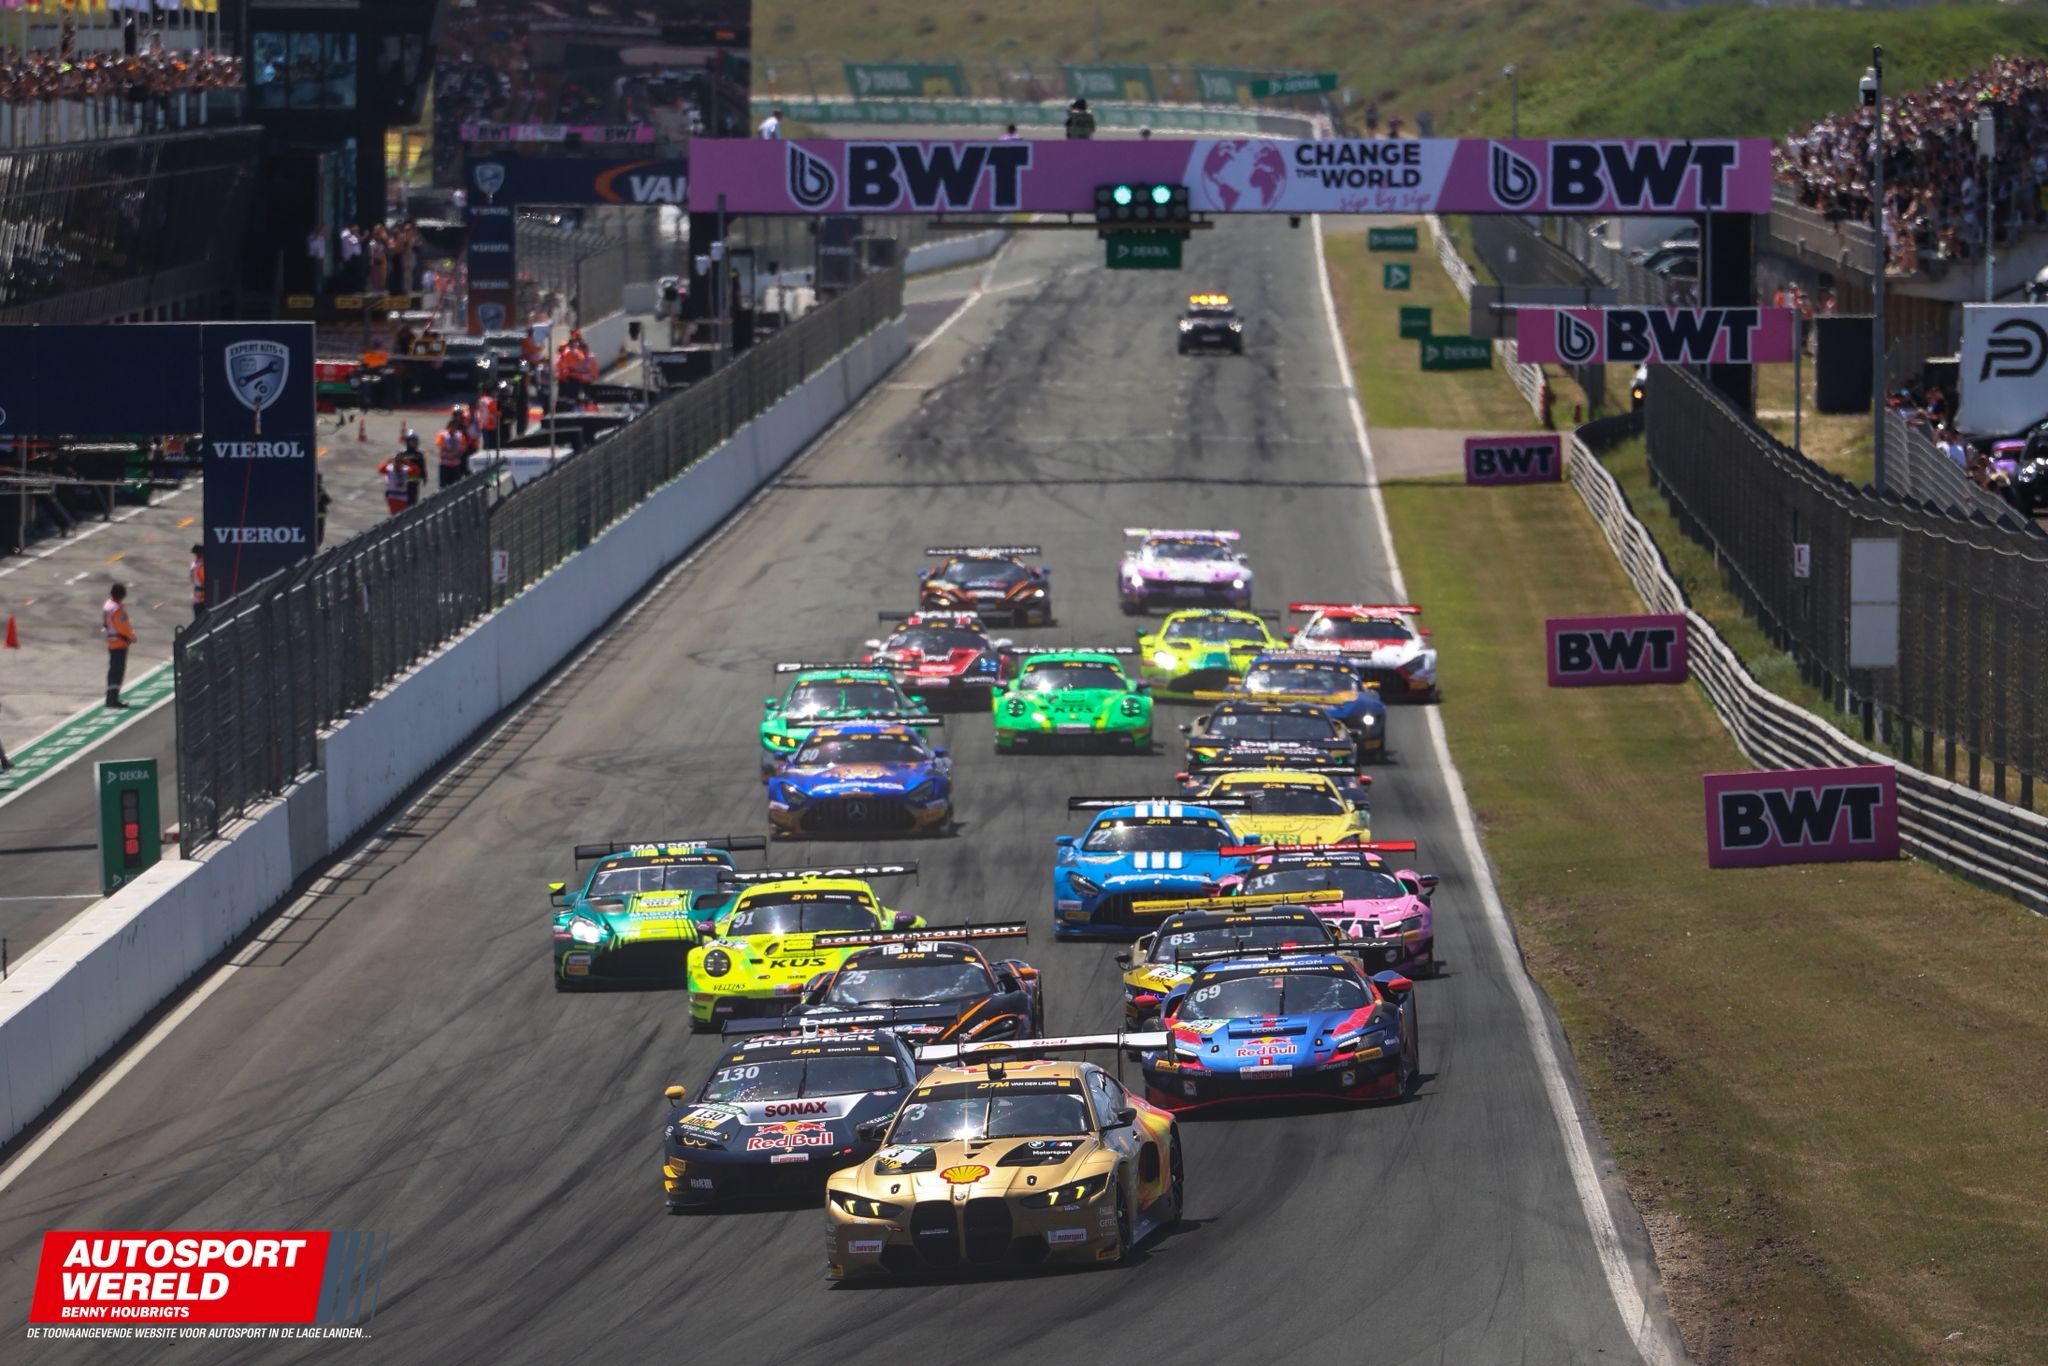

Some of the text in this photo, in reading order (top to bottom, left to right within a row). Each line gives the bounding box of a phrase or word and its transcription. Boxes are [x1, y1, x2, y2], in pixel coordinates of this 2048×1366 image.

[1295, 143, 1421, 166] CHANGE
[845, 142, 1032, 210] BWT
[1296, 168, 1421, 188] THE WORLD
[1549, 142, 1738, 209] BWT
[630, 175, 689, 202] VAI
[1606, 309, 1760, 362] BWT
[213, 442, 304, 458] VIEROL
[1473, 446, 1555, 476] BWT
[214, 527, 305, 543] VIEROL
[1556, 628, 1677, 674] BWT
[120, 770, 149, 780] DEKRA
[1719, 784, 1883, 851] BWT
[1089, 831, 1112, 845] 22
[1255, 874, 1276, 890] 14
[733, 912, 754, 929] 91
[1170, 932, 1196, 945] 63
[841, 971, 870, 986] 25
[1258, 966, 1287, 974] DTM
[1195, 984, 1222, 1002] 69
[1236, 1044, 1298, 1057] Red Bull
[719, 1066, 760, 1083] 130
[695, 1110, 724, 1121] 130
[765, 1101, 828, 1117] SONAX
[911, 1104, 928, 1121] 3
[686, 1117, 713, 1127] ADAC
[747, 1131, 833, 1151] Red Bull
